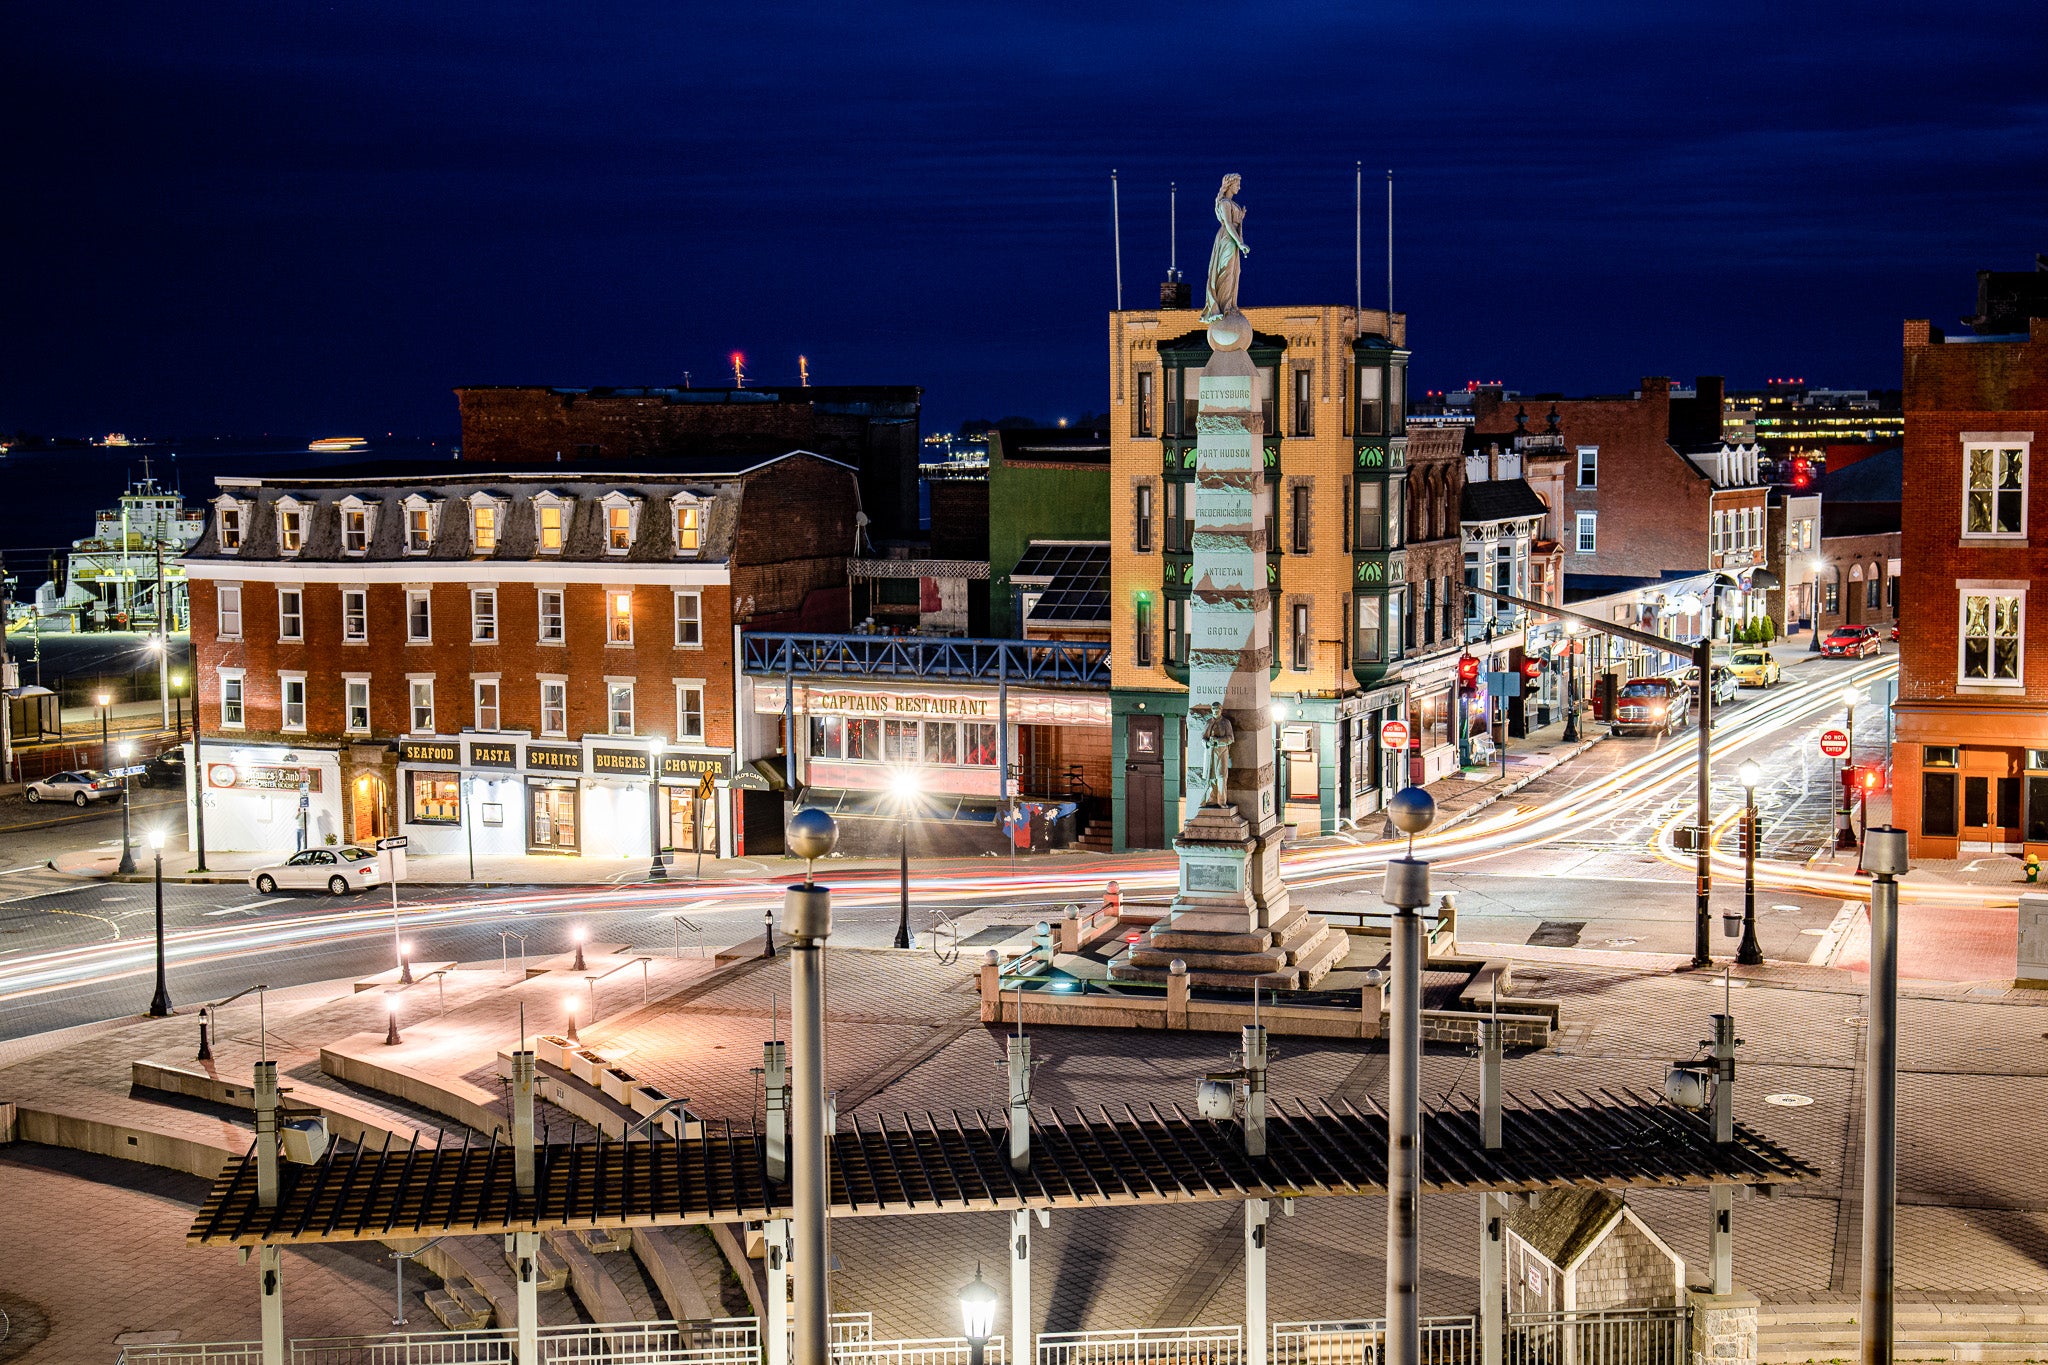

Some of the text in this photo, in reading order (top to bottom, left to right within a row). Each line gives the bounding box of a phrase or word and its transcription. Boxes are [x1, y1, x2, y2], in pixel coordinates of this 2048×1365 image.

[1200, 389, 1250, 400] GETTYSBURG
[1198, 448, 1251, 458] PORT HUDSON
[1196, 508, 1252, 518] FREDERICKSBURG
[1204, 567, 1243, 577] ANTIETAM
[1207, 626, 1239, 636] GROTON
[1196, 685, 1250, 695] BUNKER HILL
[822, 695, 987, 715] CAPTAINS RESTAURANT
[407, 746, 454, 760] SEAFOOD
[475, 748, 511, 762] PASTA
[531, 752, 578, 766] SPIRITS
[596, 754, 646, 769] BURGERS
[665, 759, 723, 774] CHOWDER
